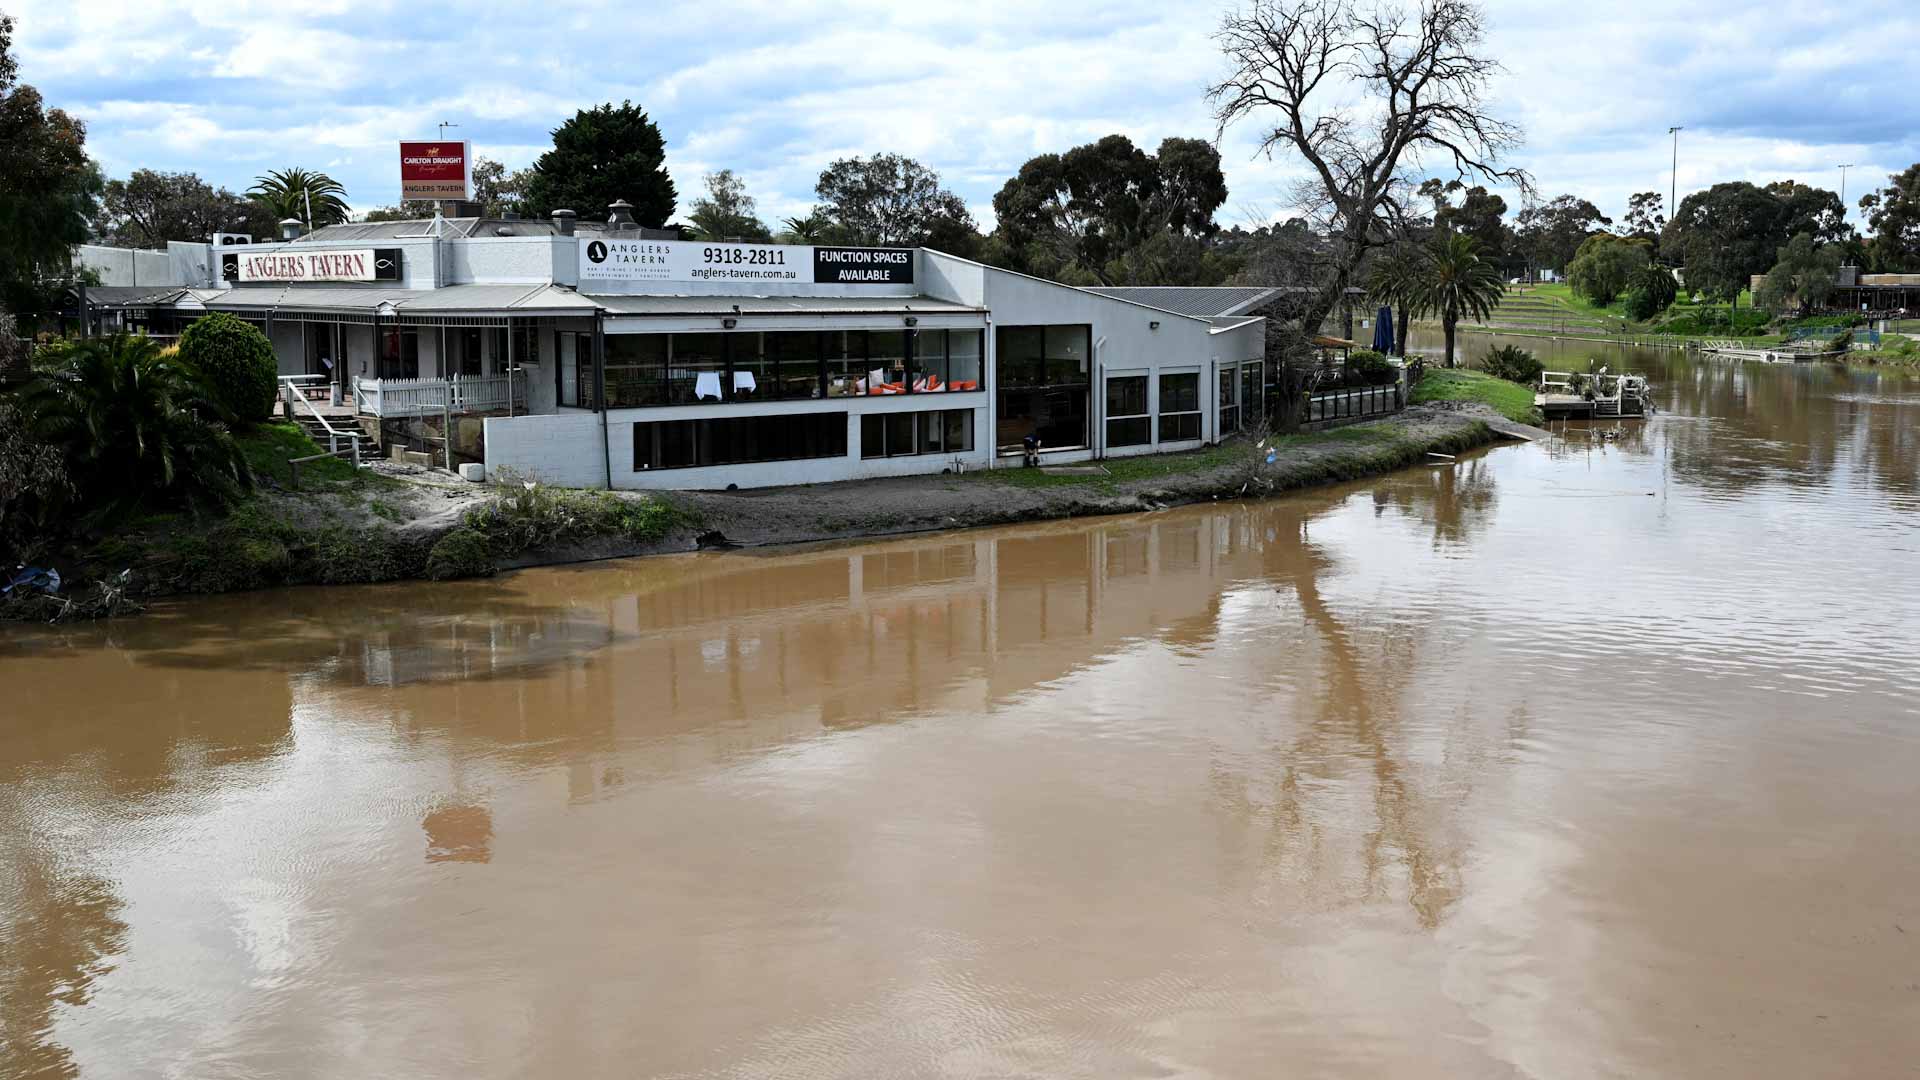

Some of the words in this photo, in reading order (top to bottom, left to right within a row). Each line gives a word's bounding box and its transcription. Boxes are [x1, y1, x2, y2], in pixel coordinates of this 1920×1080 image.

[610, 244, 670, 254] ANGLERS
[615, 254, 665, 264] TAVERN
[703, 248, 785, 265] 9318-2811
[819, 251, 871, 263] FUNCTION
[873, 252, 908, 264] SPACES
[246, 255, 305, 278] ANGLERS
[308, 254, 365, 277] TAVERN
[691, 267, 796, 280] anglers-tavern.com.au
[838, 269, 890, 281] AVAILABLE
